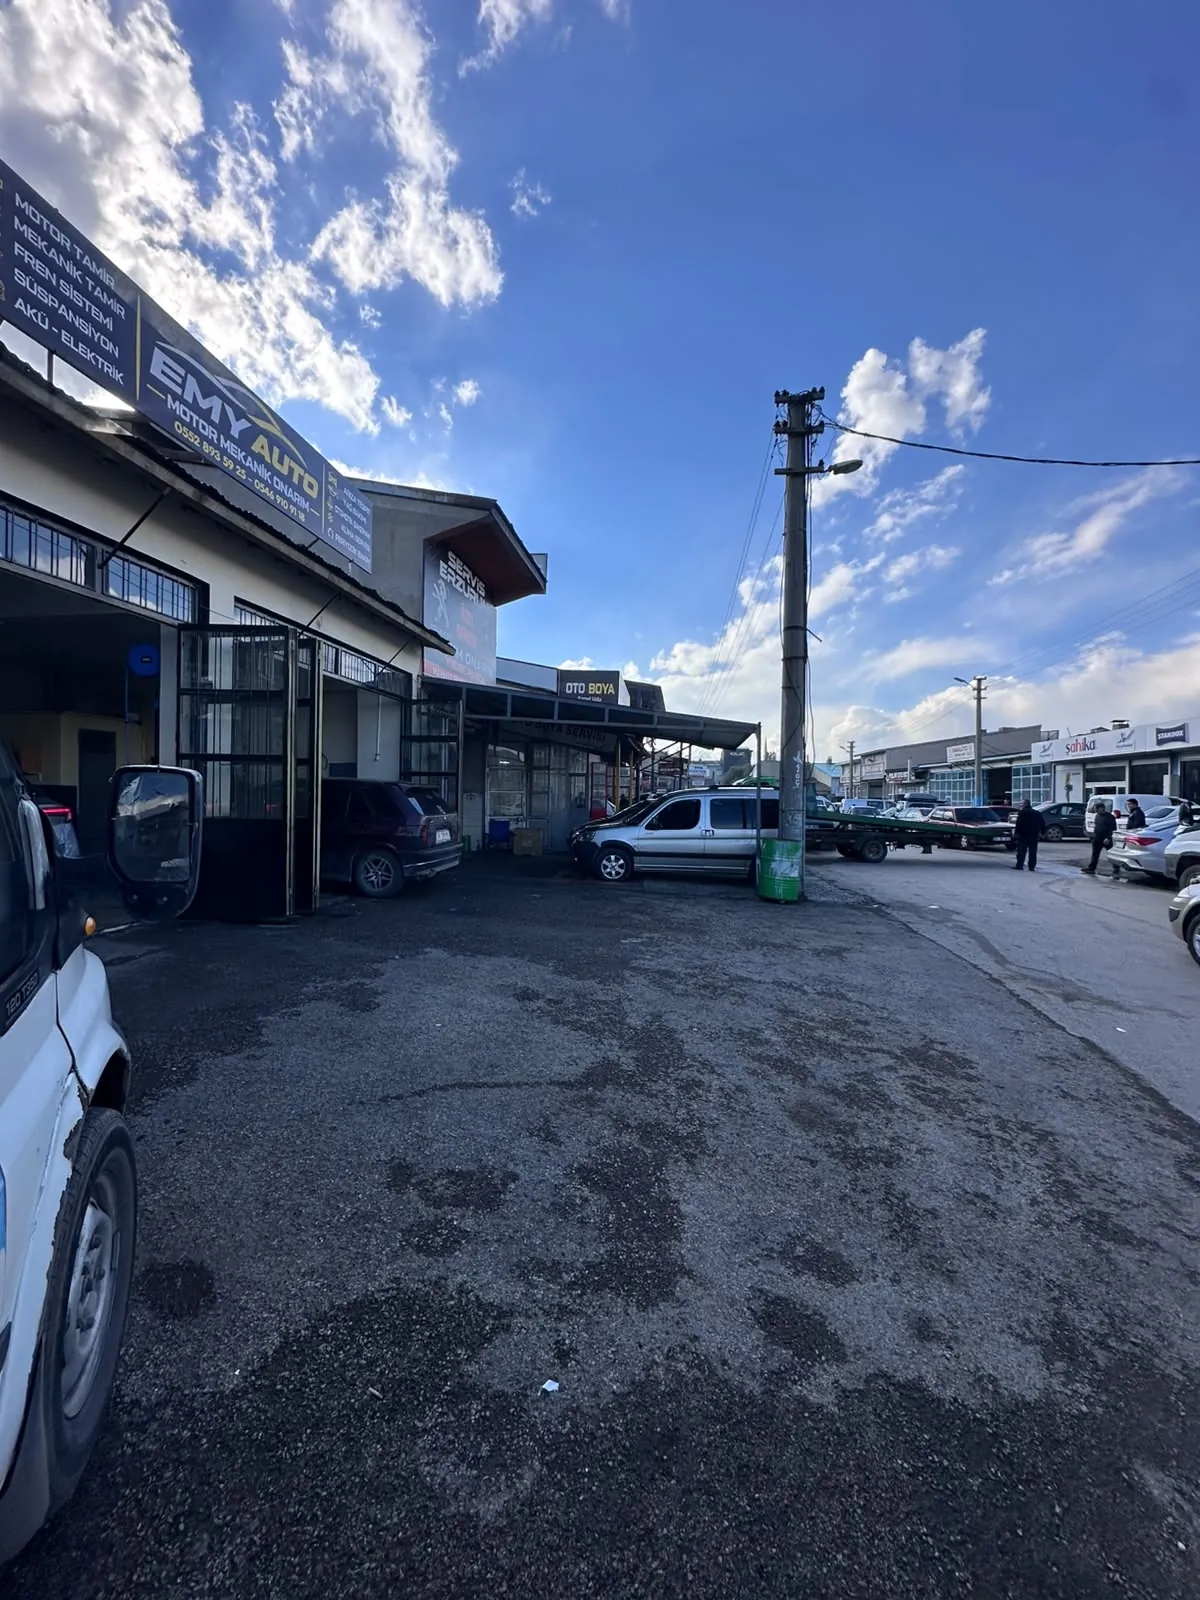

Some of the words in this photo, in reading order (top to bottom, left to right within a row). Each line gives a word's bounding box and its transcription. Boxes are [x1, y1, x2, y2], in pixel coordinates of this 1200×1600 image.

[14, 215, 83, 284] MEKANİK
[85, 276, 126, 320] TAMİR
[14, 240, 56, 286] FREN
[60, 279, 113, 331] SİSTEMİ
[15, 192, 71, 252] MOTOR
[73, 244, 115, 290] TAMİR
[14, 267, 119, 358] SÜSPANSİYON
[14, 298, 49, 330] AKÜ
[61, 329, 124, 386] ELEKTRİK
[150, 346, 252, 439] EMY
[251, 434, 318, 499] AUTO
[167, 393, 218, 444] MOTOR
[220, 434, 272, 484] MEKANİK
[273, 476, 310, 513] ONARIM
[174, 421, 201, 447] 0552
[202, 441, 221, 462] 893
[222, 456, 234, 470] 59
[235, 465, 247, 480] 25
[448, 550, 486, 598] SERVİS
[565, 682, 586, 694] OTO
[588, 683, 615, 695] BOYA
[1065, 737, 1096, 756] şahika
